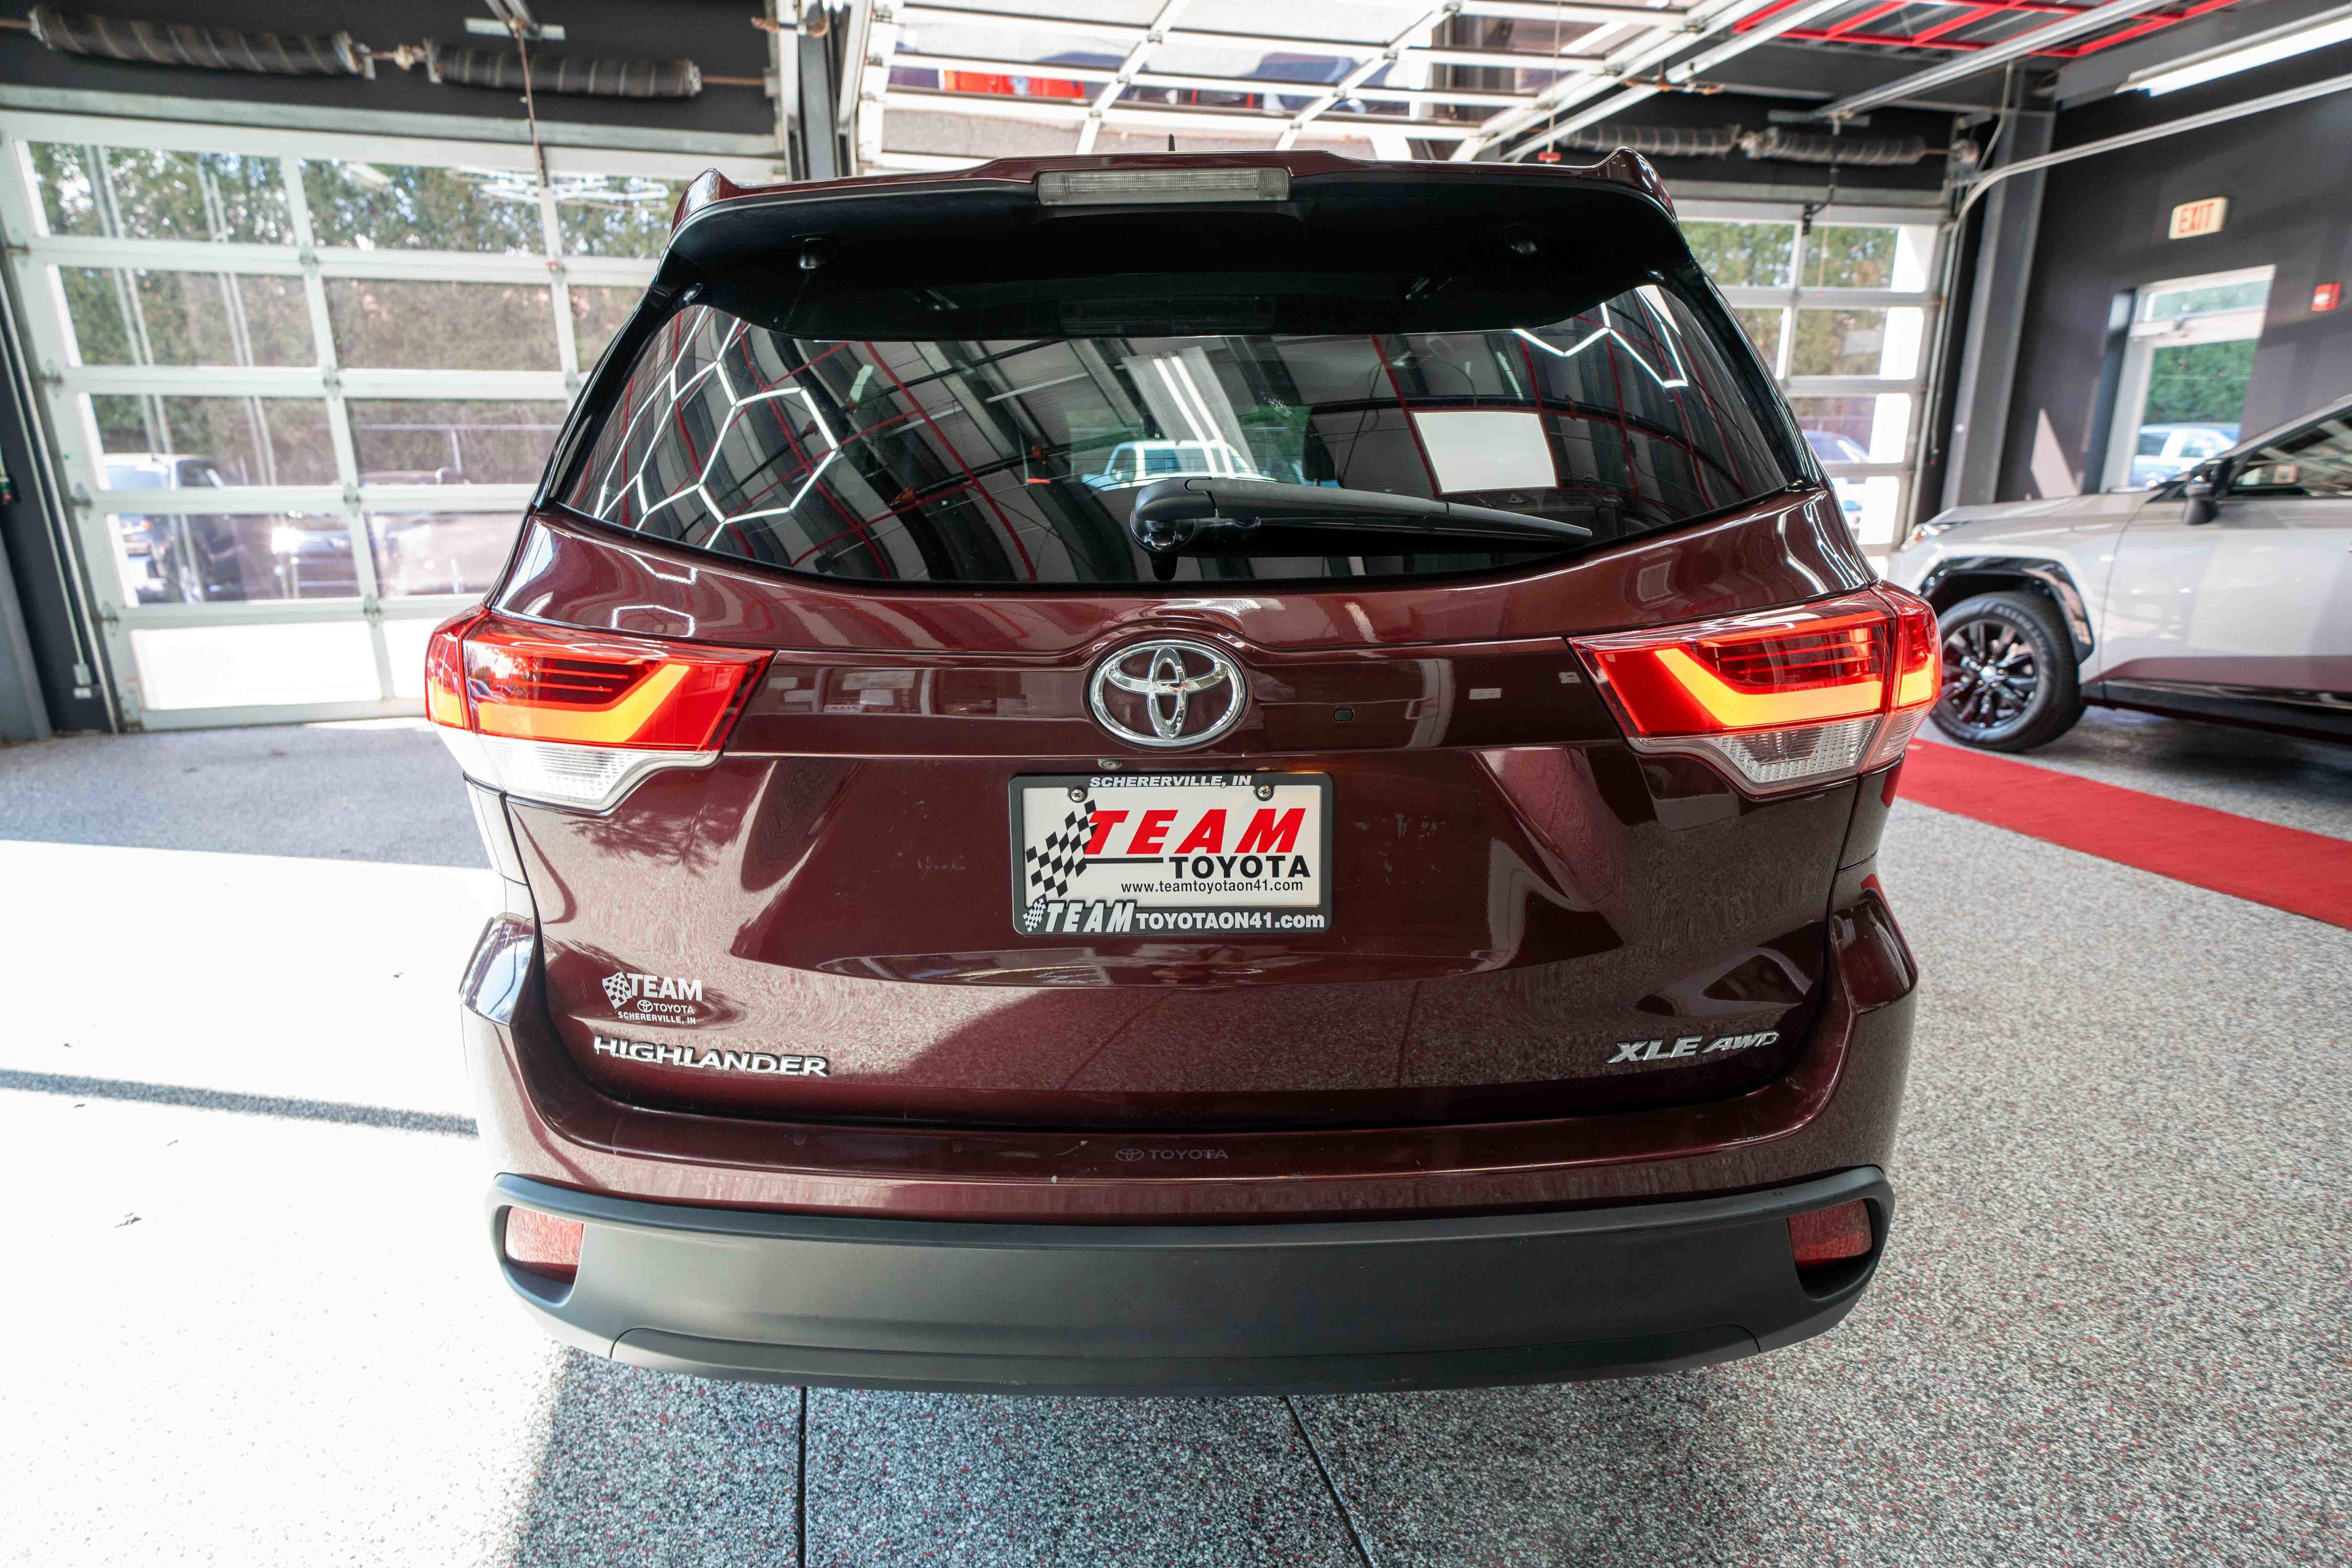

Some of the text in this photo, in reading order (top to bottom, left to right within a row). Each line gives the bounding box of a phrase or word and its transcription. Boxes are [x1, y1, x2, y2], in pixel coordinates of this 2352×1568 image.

[2178, 203, 2214, 233] EXIT
[1089, 775, 1252, 788] SCHERERVILLE, IN
[1084, 808, 1306, 855] TEAM
[1169, 855, 1310, 879] TOYOTA
[1121, 880, 1303, 894] www.teamtoyotaon41.com
[1045, 900, 1325, 933] TEAM TOYOTAON41.com
[627, 973, 702, 1001] TEAM
[618, 1011, 684, 1024] SCHERERVILLE,
[653, 1003, 695, 1014] TOYOTA
[593, 1035, 829, 1077] HIGHLANDER
[1607, 1030, 1780, 1063] XLE AWD
[1148, 1149, 1229, 1160] TOYOTA
